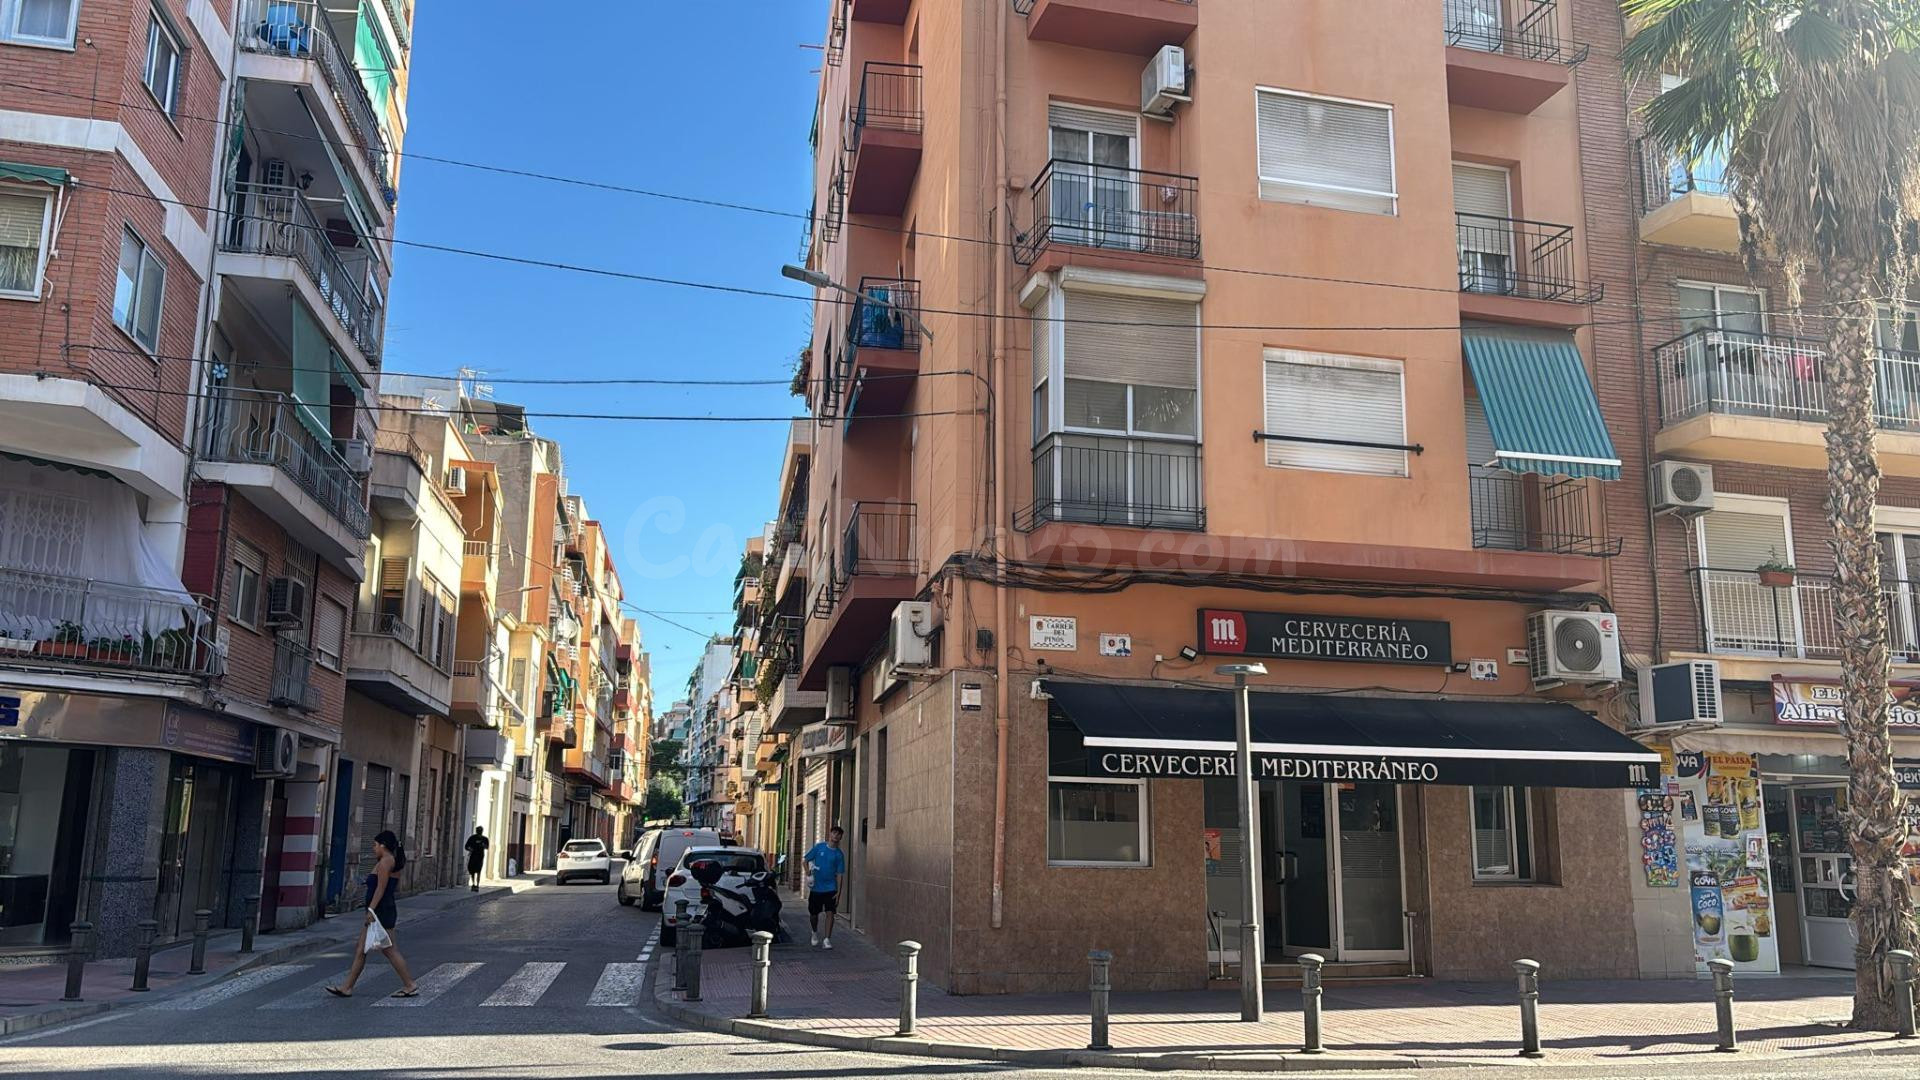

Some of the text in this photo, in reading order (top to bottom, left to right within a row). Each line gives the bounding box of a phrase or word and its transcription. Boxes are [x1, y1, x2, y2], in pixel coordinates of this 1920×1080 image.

[1285, 620, 1411, 641] CERVECERÍA
[1272, 637, 1429, 660] MEDITERRANEO
[1102, 752, 1438, 781] CERVECERÍ MEDITERRÁNEO
